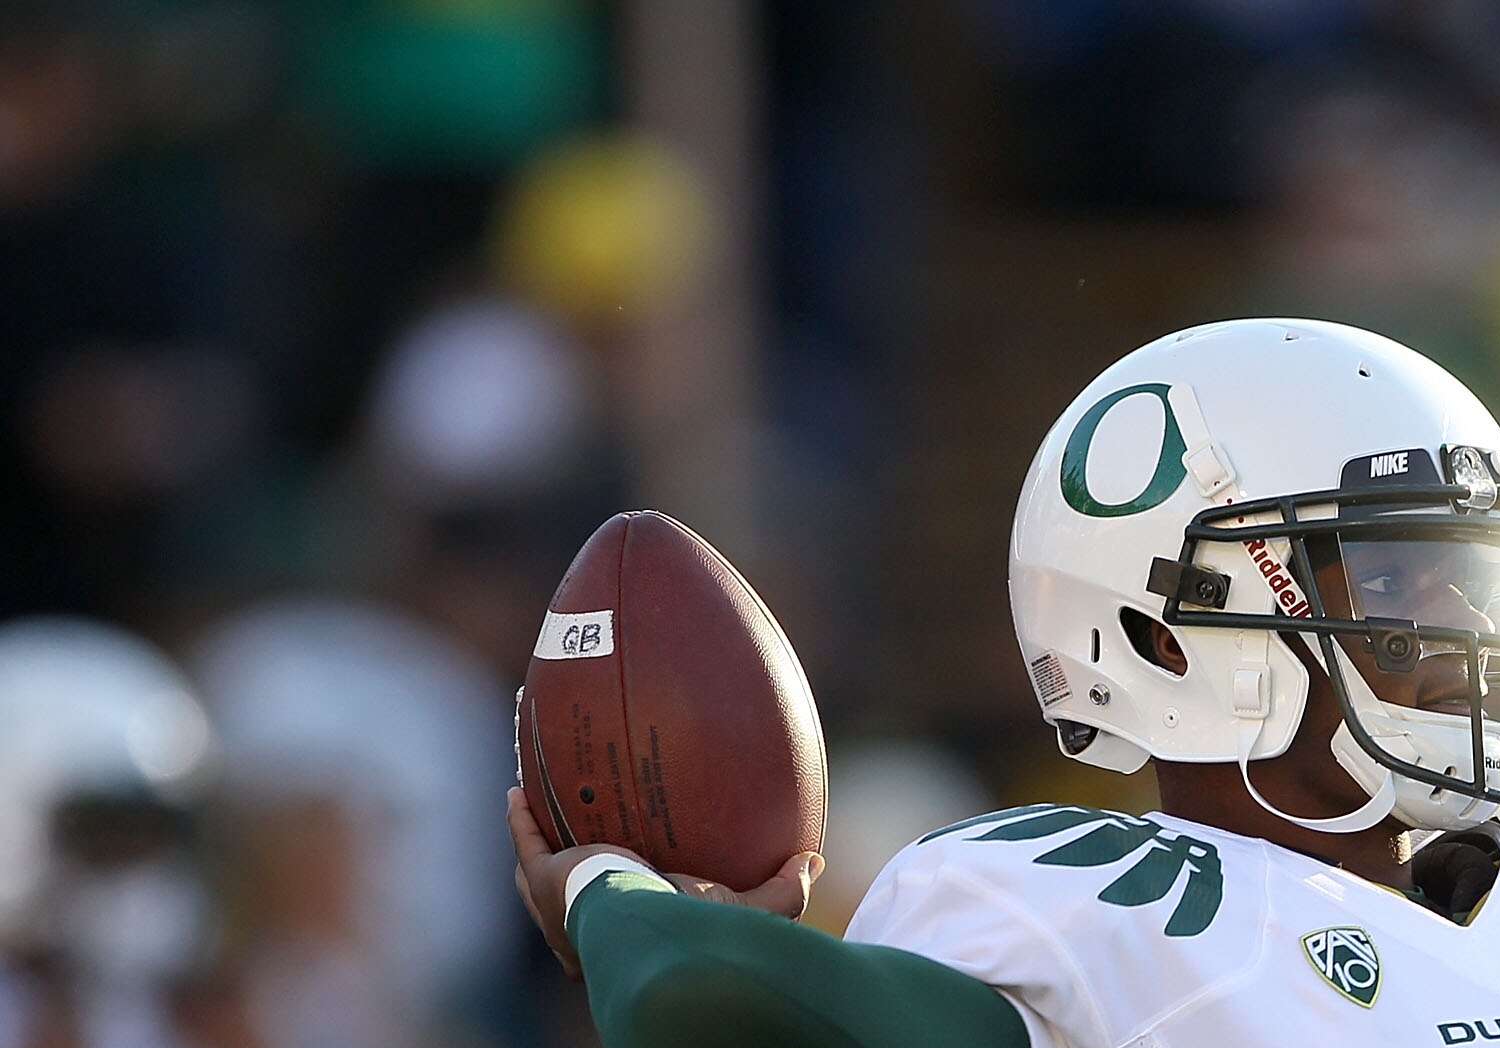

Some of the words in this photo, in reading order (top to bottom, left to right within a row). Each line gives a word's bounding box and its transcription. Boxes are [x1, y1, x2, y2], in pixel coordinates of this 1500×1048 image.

[1060, 382, 1188, 517] O
[1370, 451, 1409, 478] NIKE
[1242, 538, 1312, 618] Riddell
[1304, 929, 1379, 980] PAC
[1334, 958, 1377, 993] 10
